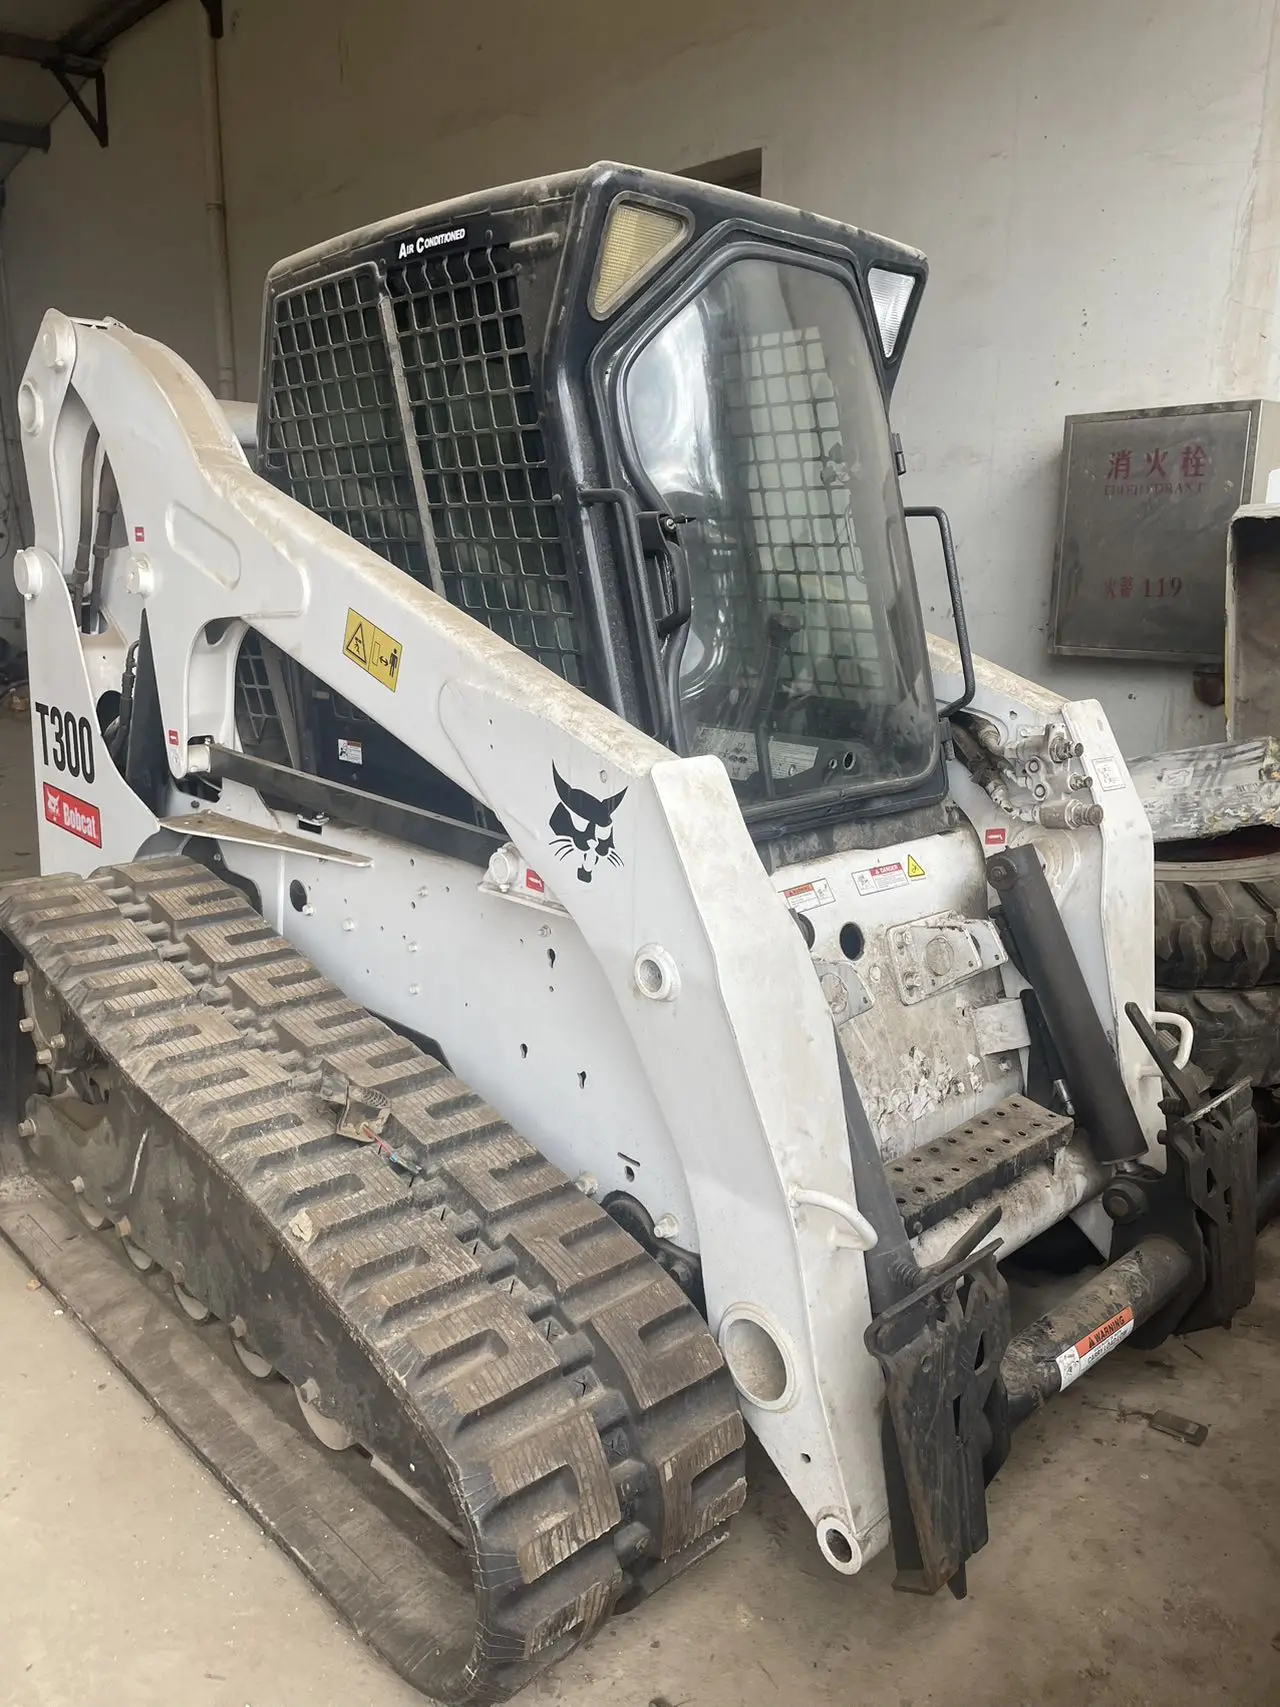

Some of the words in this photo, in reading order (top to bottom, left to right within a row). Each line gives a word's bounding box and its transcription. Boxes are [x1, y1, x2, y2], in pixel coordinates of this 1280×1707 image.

[1106, 445, 1206, 479] 消火栓
[35, 702, 95, 784] T300
[62, 802, 97, 838] Bobcat
[1093, 1315, 1125, 1344] WARNING
